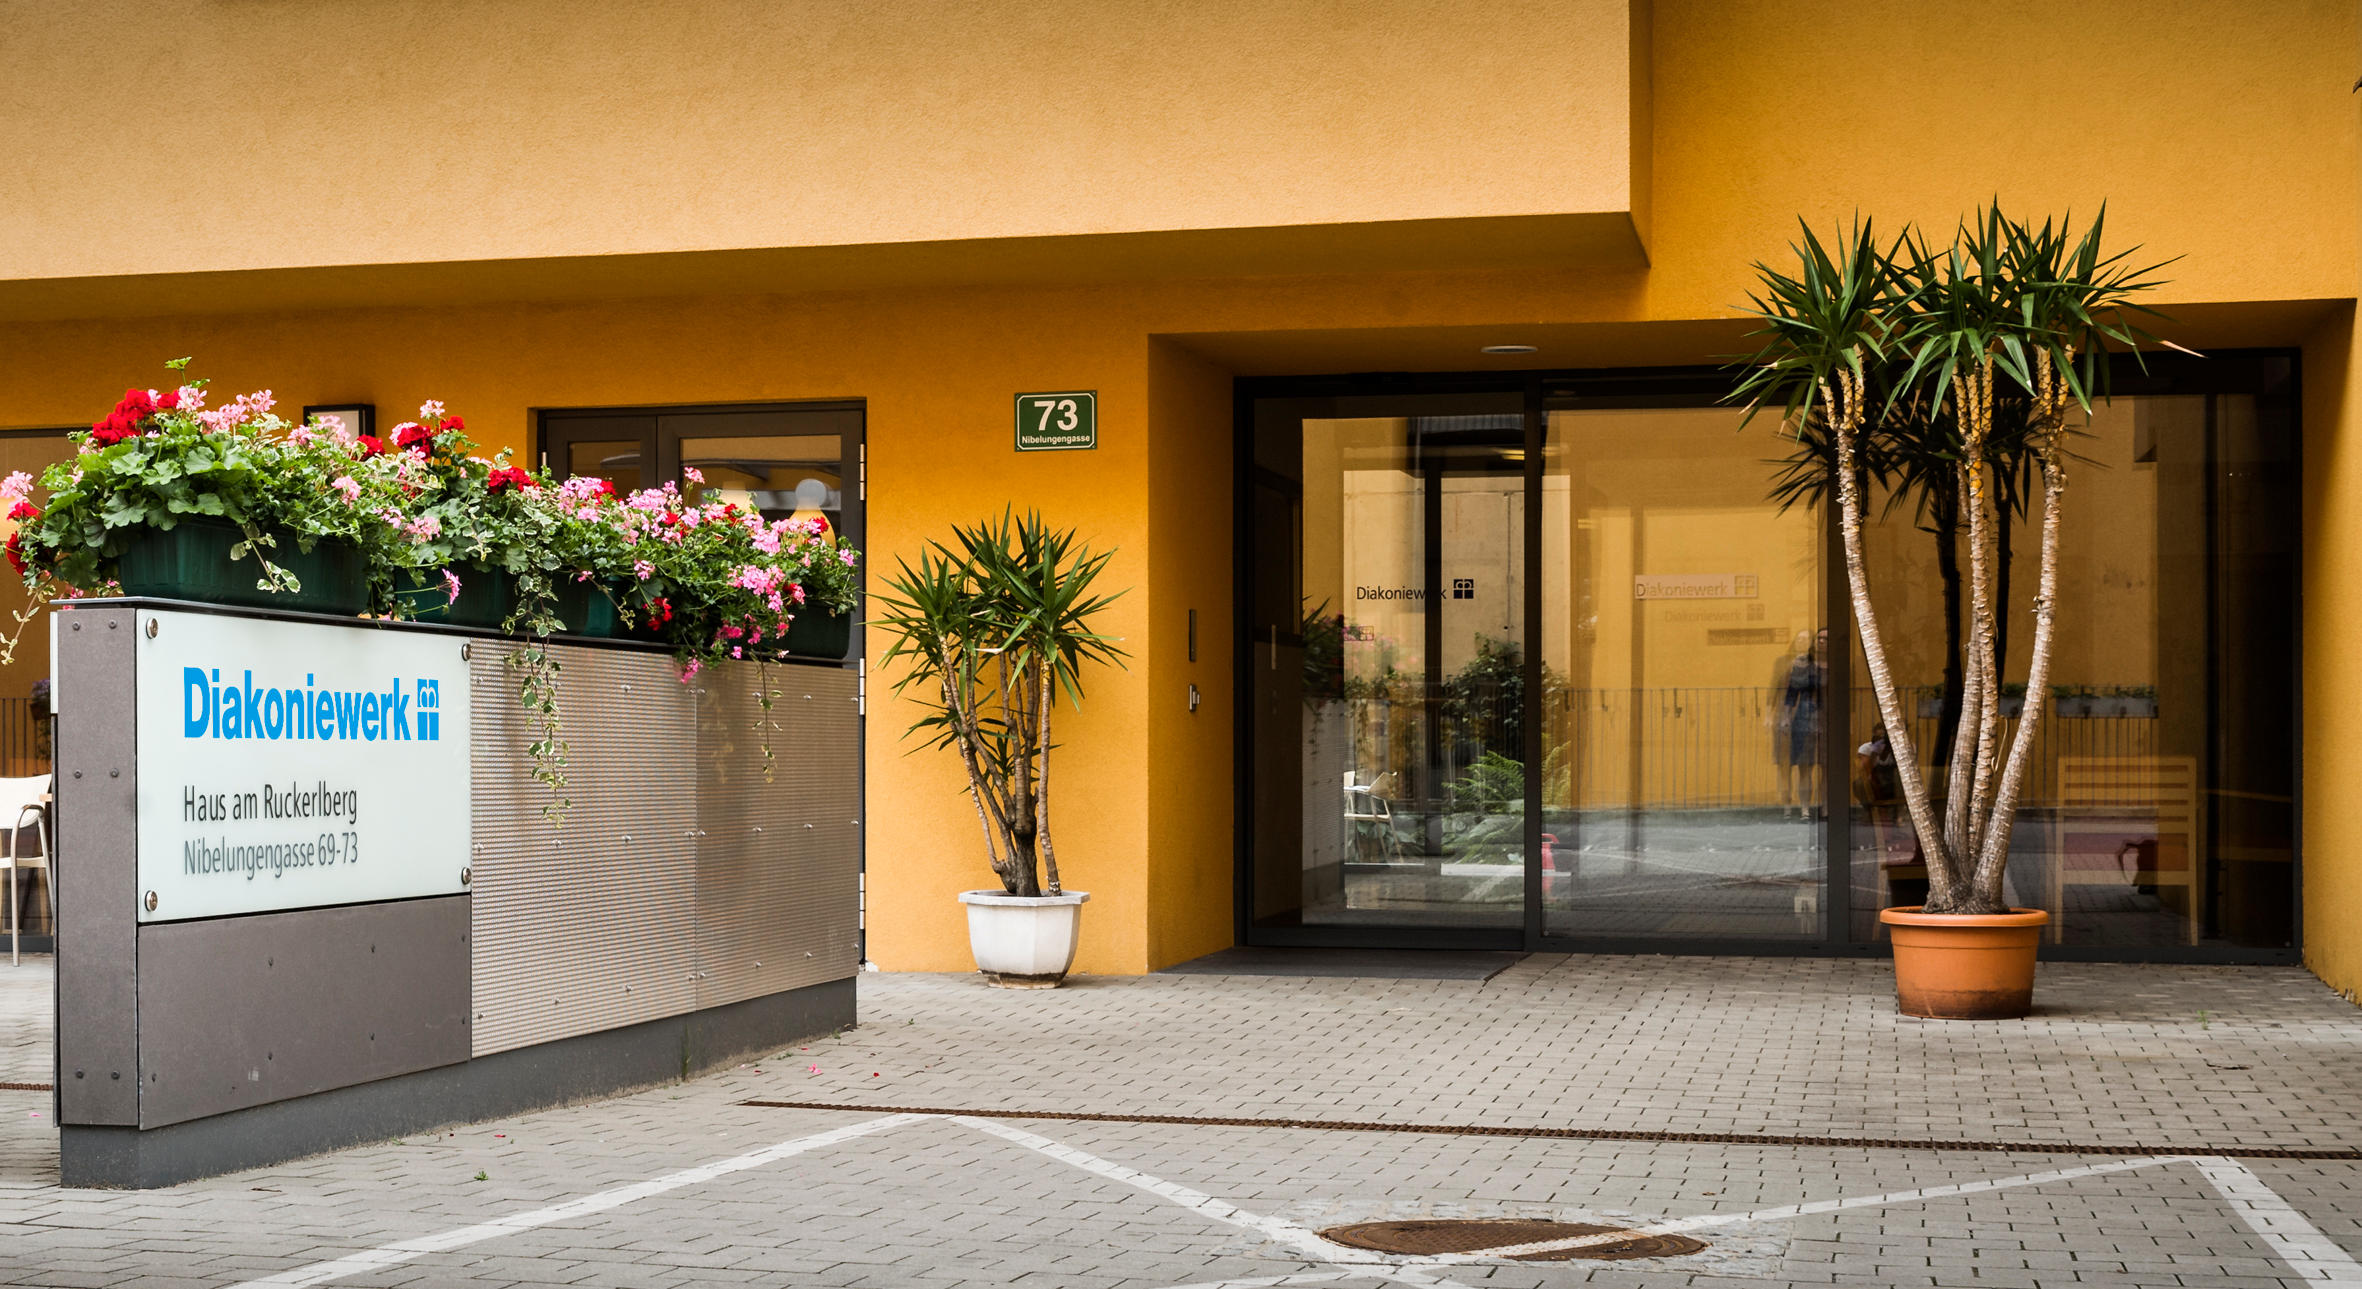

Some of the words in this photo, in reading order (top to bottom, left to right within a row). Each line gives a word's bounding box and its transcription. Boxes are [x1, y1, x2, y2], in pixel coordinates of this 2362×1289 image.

[1034, 400, 1078, 431] 73
[1022, 435, 1090, 444] Nibelungengasse
[1356, 586, 1447, 600] Diakoniewk
[184, 667, 411, 741] Diakoniewerk
[184, 785, 226, 822] Haus
[232, 791, 258, 820] am
[264, 781, 357, 825] Ruckerlberg
[185, 836, 315, 880] Nibelungengasse
[317, 832, 358, 866] 69-73
